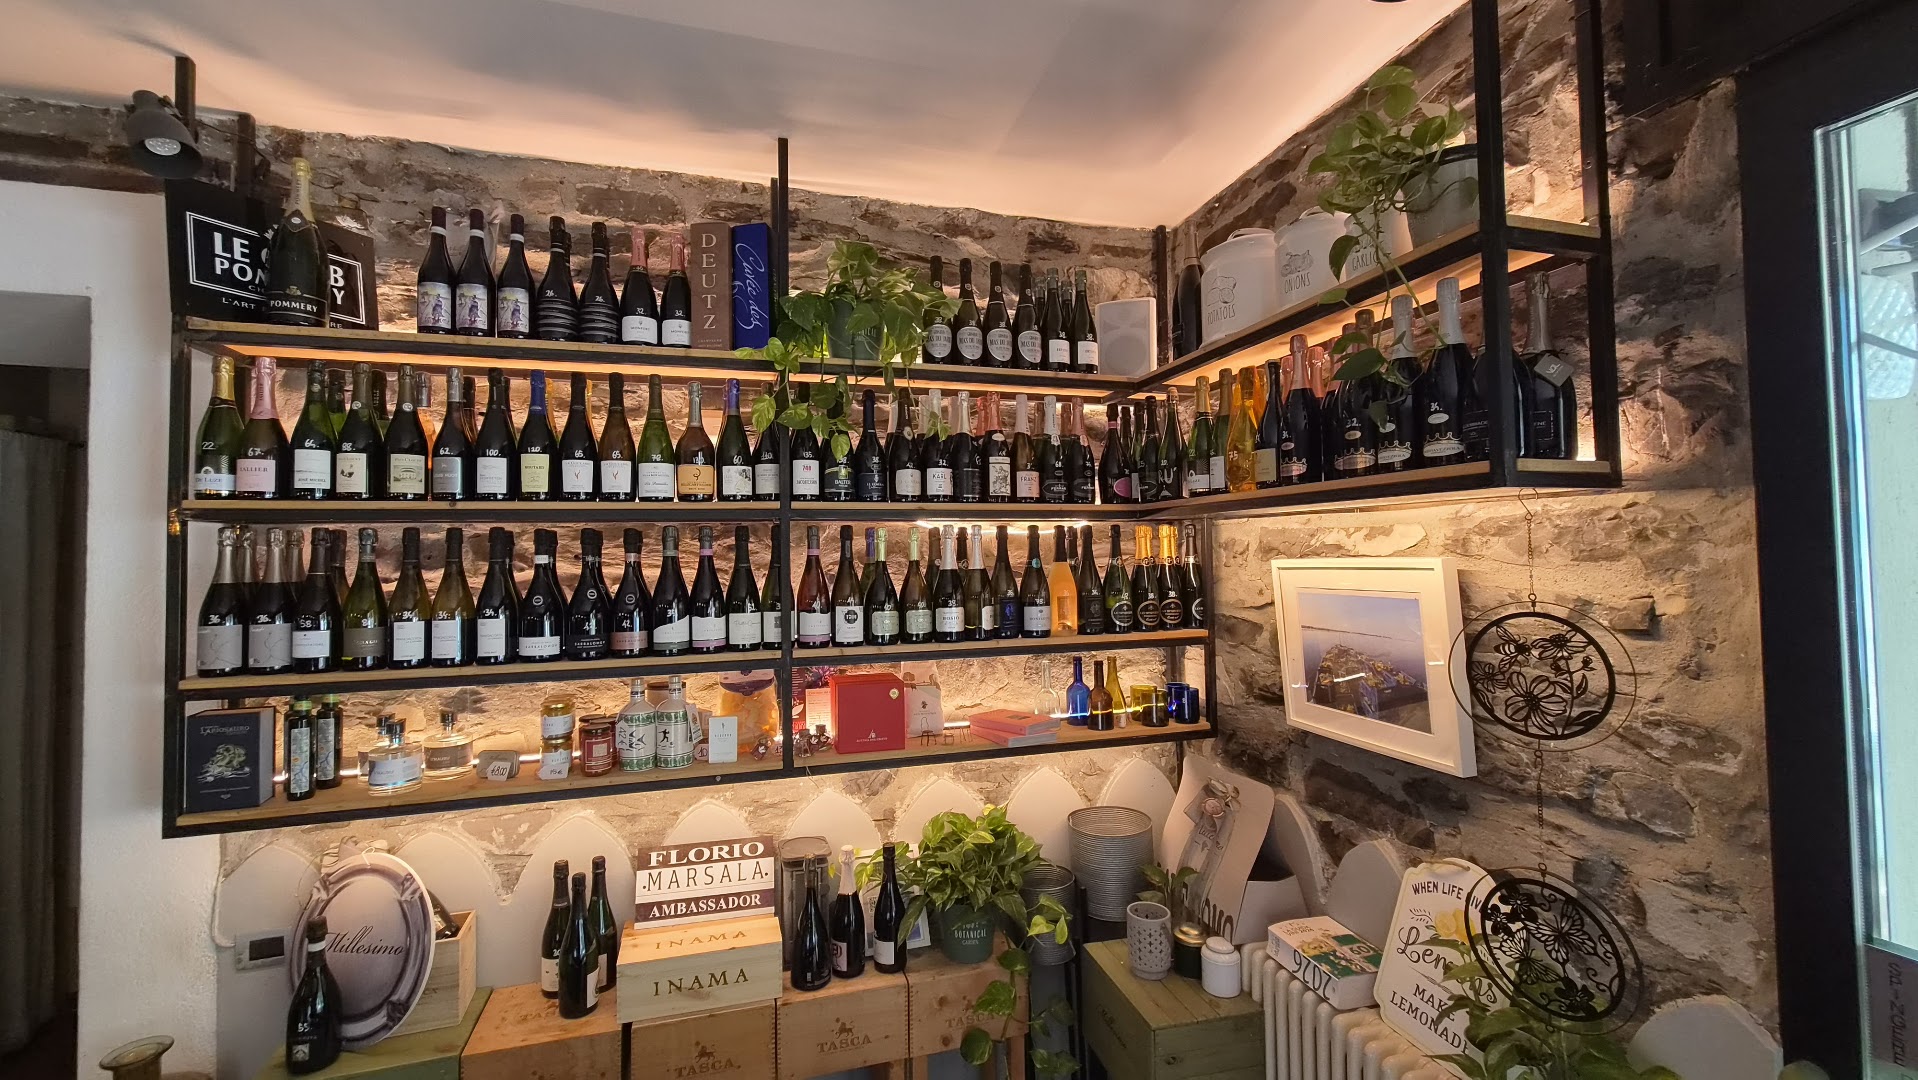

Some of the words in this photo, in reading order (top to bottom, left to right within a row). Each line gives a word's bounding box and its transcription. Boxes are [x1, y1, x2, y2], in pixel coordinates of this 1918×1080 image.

[213, 231, 250, 263] LE
[701, 233, 717, 329] DEUTZ
[1284, 272, 1311, 294] ONIONS
[270, 299, 318, 313] POMMERY
[1207, 305, 1236, 325] POTATOES
[486, 449, 501, 457] 100.
[1228, 450, 1239, 461] 75
[648, 841, 765, 867] FLORIO
[647, 860, 765, 892] MARSALA
[1411, 881, 1438, 896] WHEN
[1441, 884, 1464, 900] LIFE
[649, 893, 762, 919] AMBASSADOR
[323, 925, 406, 956] Millesimo
[655, 930, 748, 950] INAMA
[954, 928, 987, 939] BOTANICAL
[653, 968, 749, 997] INAMA
[1292, 949, 1332, 1000] 2026
[816, 1034, 872, 1054] TASCA
[674, 1057, 735, 1079] TASCA
